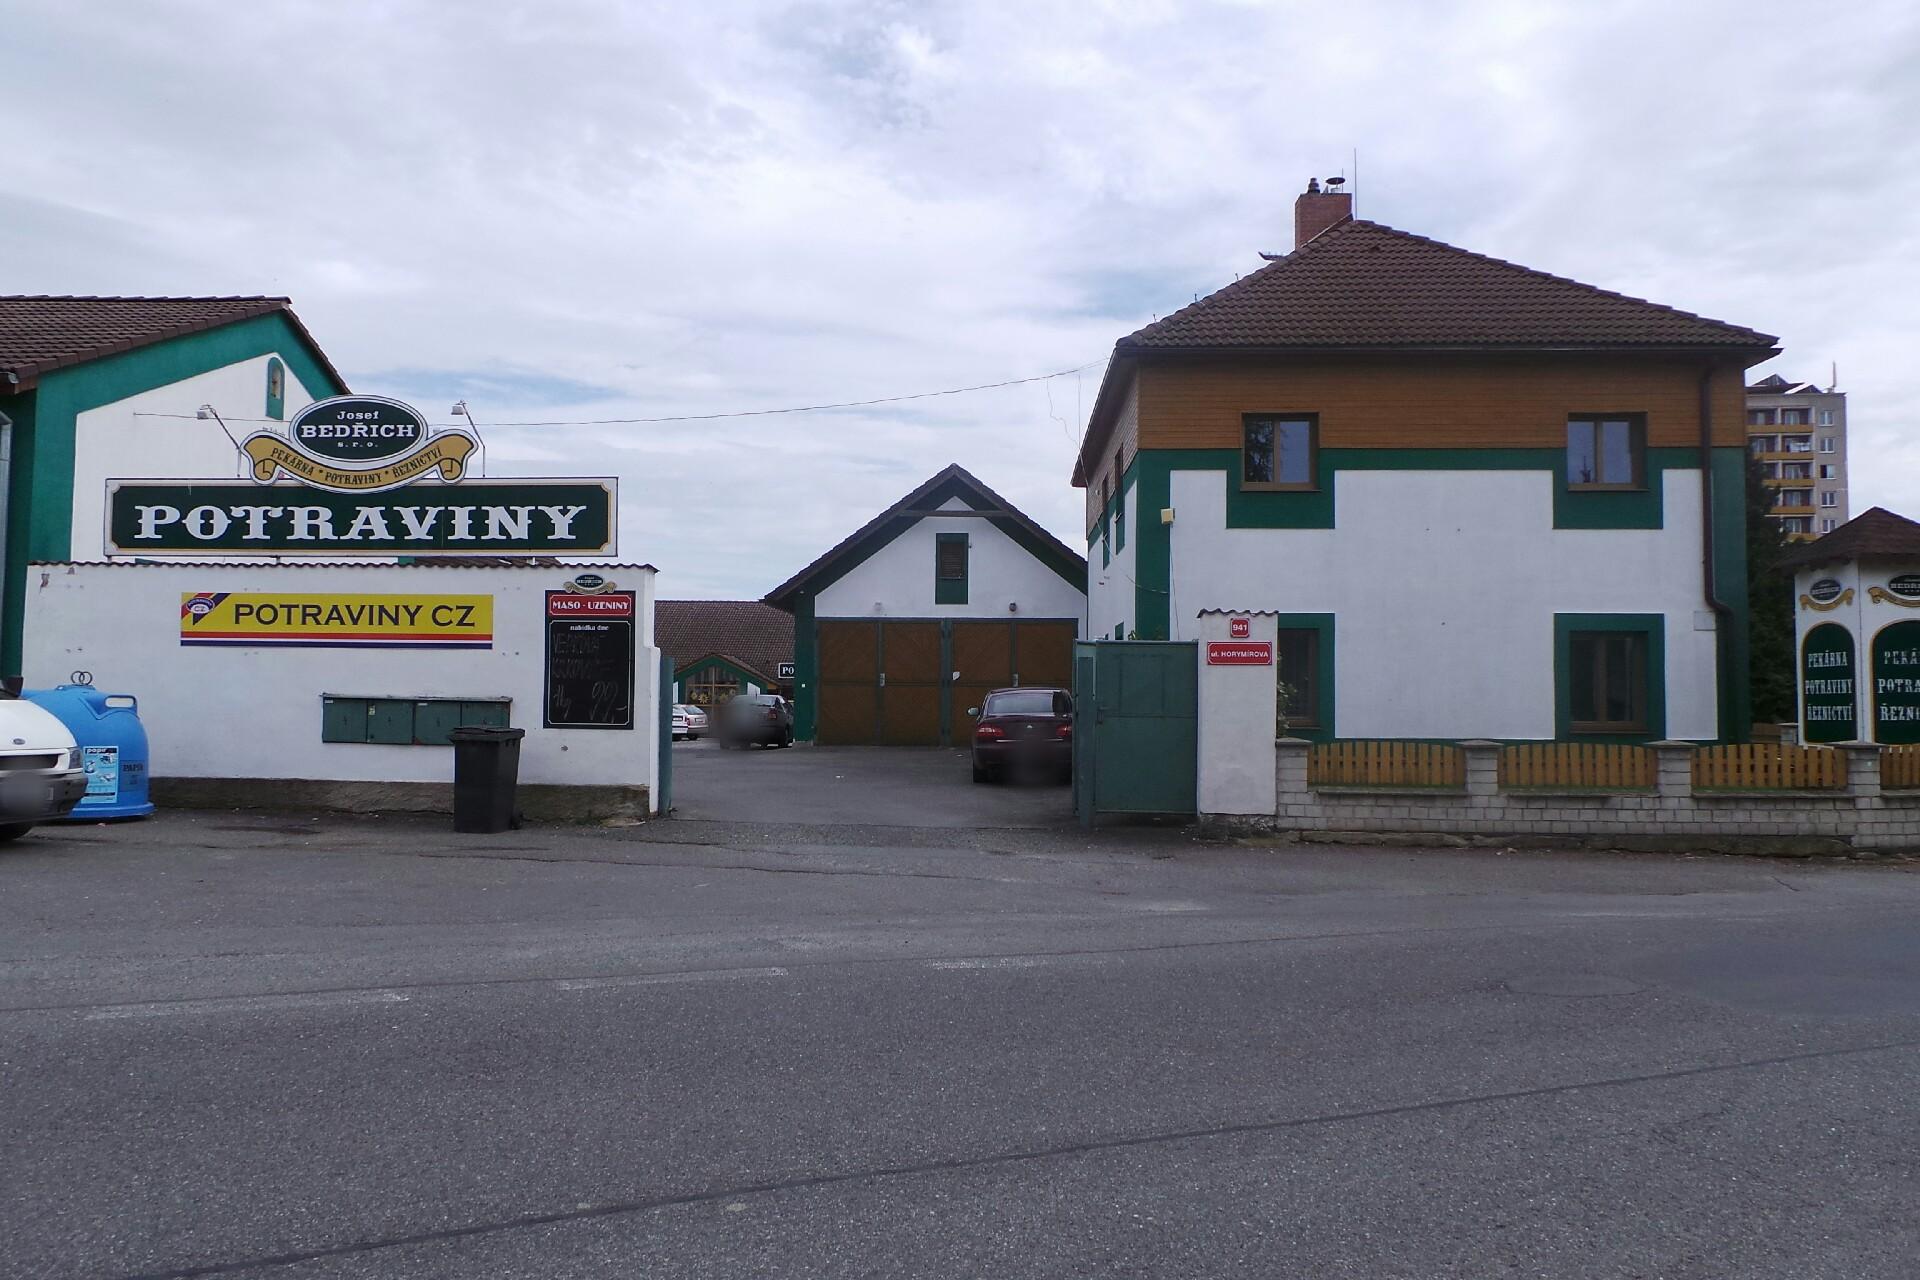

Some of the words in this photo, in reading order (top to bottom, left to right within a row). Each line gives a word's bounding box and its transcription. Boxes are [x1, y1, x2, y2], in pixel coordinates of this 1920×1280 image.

[337, 411, 380, 420] Josef
[301, 421, 415, 438] BEDŘICH
[270, 447, 314, 476] PEKÁRNA
[325, 471, 383, 485] POTRAVINY
[393, 445, 443, 478] ŘEZNICTVÍ
[134, 505, 587, 541] POTRAVINY
[553, 601, 580, 609] MASO
[587, 601, 629, 610] UZENINY
[234, 603, 423, 626] POTRAVINY
[431, 604, 475, 627] CZ
[1221, 649, 1268, 657] HORYMÍROVA
[1808, 649, 1848, 667] PEKÁRNA
[1805, 678, 1852, 695] POTRAVINY
[1807, 703, 1852, 721] ŘEZNICTVÍ
